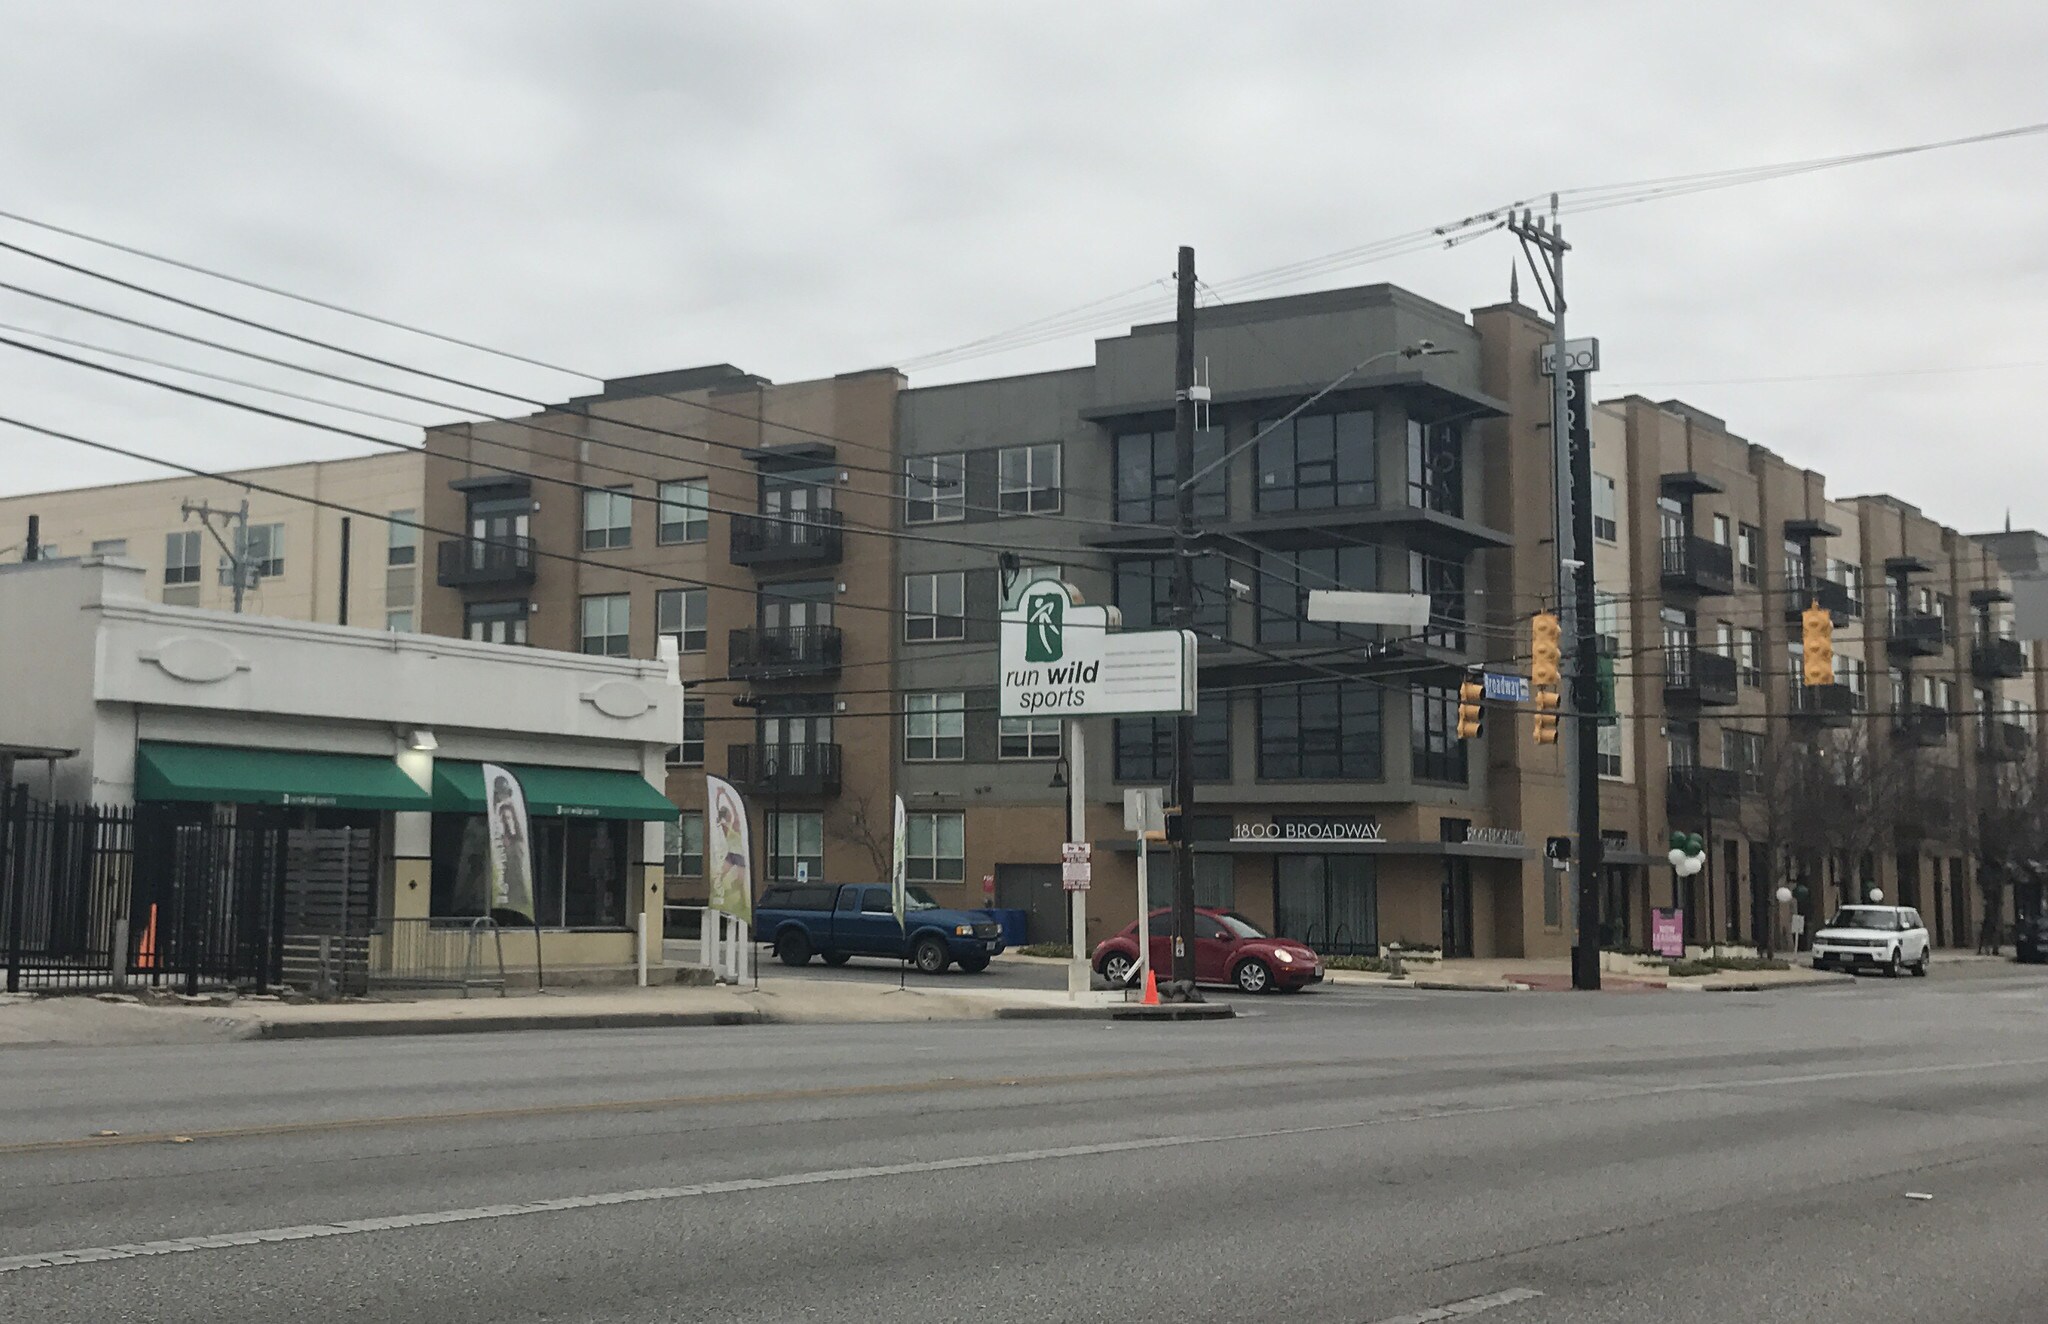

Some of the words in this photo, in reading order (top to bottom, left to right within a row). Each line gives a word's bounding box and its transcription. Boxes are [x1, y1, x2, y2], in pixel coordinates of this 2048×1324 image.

[1006, 669, 1039, 687] run
[1048, 660, 1098, 684] wild
[1019, 687, 1085, 712] sports
[1235, 823, 1280, 839] 1800
[1285, 823, 1382, 839] BROADWAY
